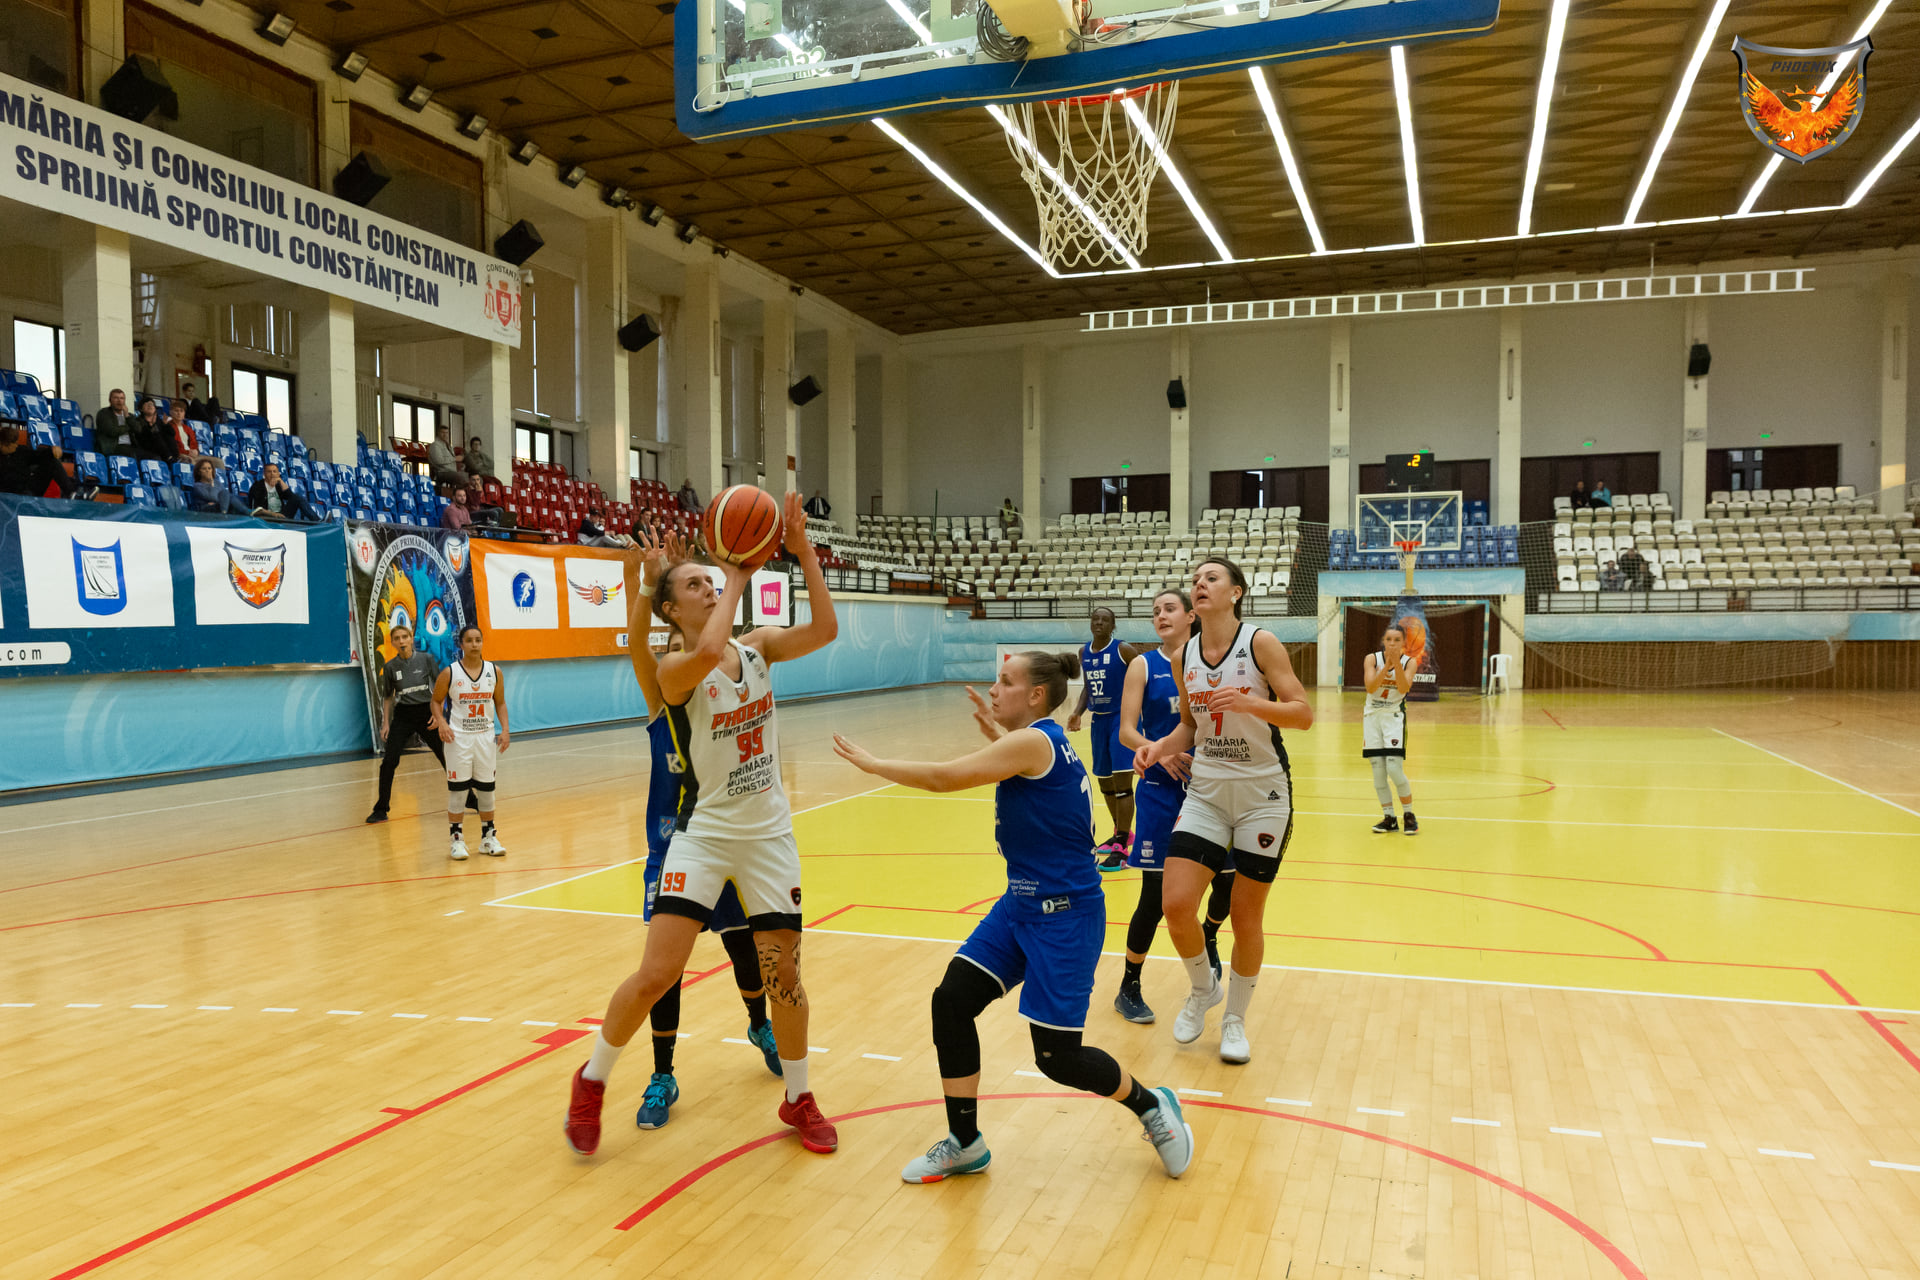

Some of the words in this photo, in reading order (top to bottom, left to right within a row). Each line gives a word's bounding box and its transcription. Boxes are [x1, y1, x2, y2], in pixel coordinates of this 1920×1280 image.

[0, 89, 105, 157] MĂRIA
[151, 146, 288, 220] CONSILIUL
[294, 197, 361, 245] LOCAL
[367, 224, 478, 287] CONSTANȚA
[15, 145, 161, 220] SPRIJINĂ
[166, 195, 283, 259] SPORTUL
[289, 236, 439, 307] CONSTĂNȚEAN
[1086, 670, 1106, 680] KSE
[1090, 681, 1104, 696] 32
[1380, 689, 1389, 699] 4
[468, 704, 485, 718] 34
[1211, 712, 1223, 736] 7
[737, 725, 764, 763] 99
[663, 872, 686, 892] 99
